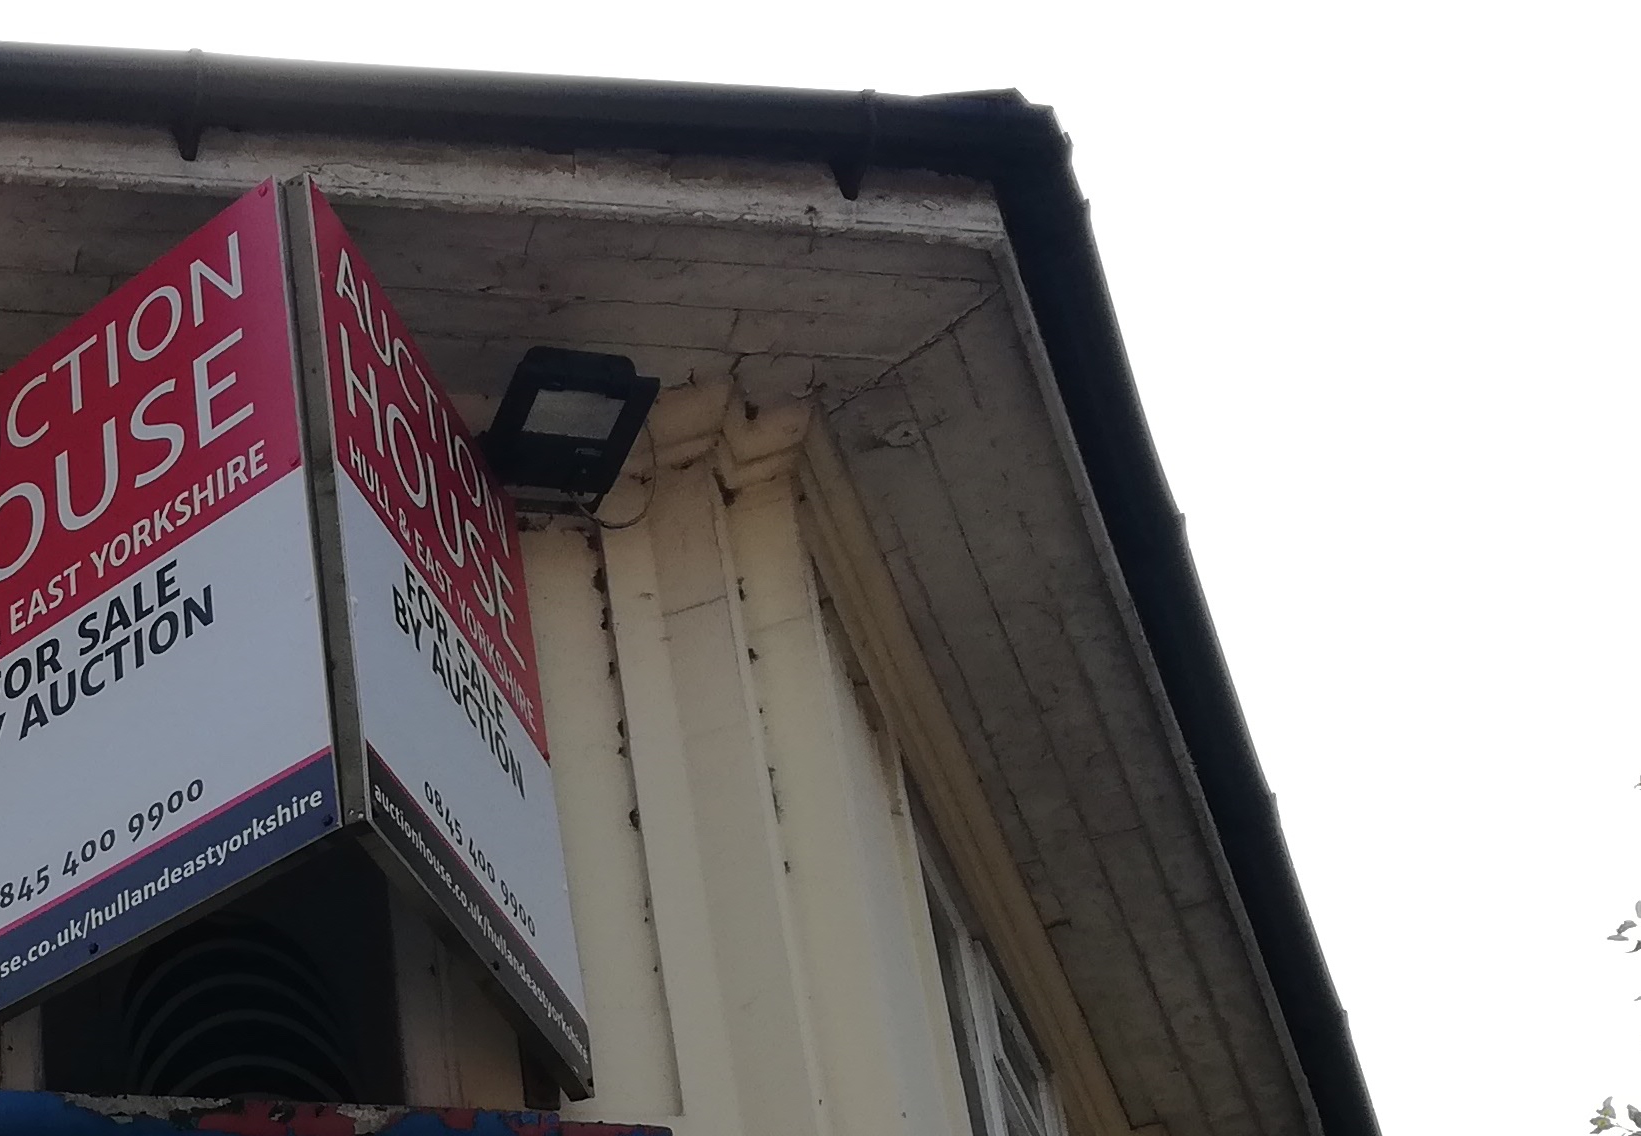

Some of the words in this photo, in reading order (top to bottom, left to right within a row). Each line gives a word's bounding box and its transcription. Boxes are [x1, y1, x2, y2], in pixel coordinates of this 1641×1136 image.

[336, 247, 510, 558] AUCTION
[9, 561, 83, 634] EAST
[89, 439, 269, 580] YORKSHIRE
[339, 322, 526, 671] HOUSE
[349, 438, 394, 522] HULL
[399, 507, 413, 546] &
[413, 528, 453, 606] EAST
[456, 588, 537, 733] YORKSHIRE
[19, 584, 214, 740] AUCTION
[77, 559, 181, 656] SALE
[392, 583, 422, 654] BY
[432, 640, 526, 800] AUCTION
[403, 561, 452, 657] FOR
[458, 643, 508, 738] SALE
[62, 828, 116, 877] 400
[127, 778, 204, 842] 9900
[423, 781, 463, 846] 0845
[468, 837, 496, 884] 400
[500, 879, 536, 937] 9900
